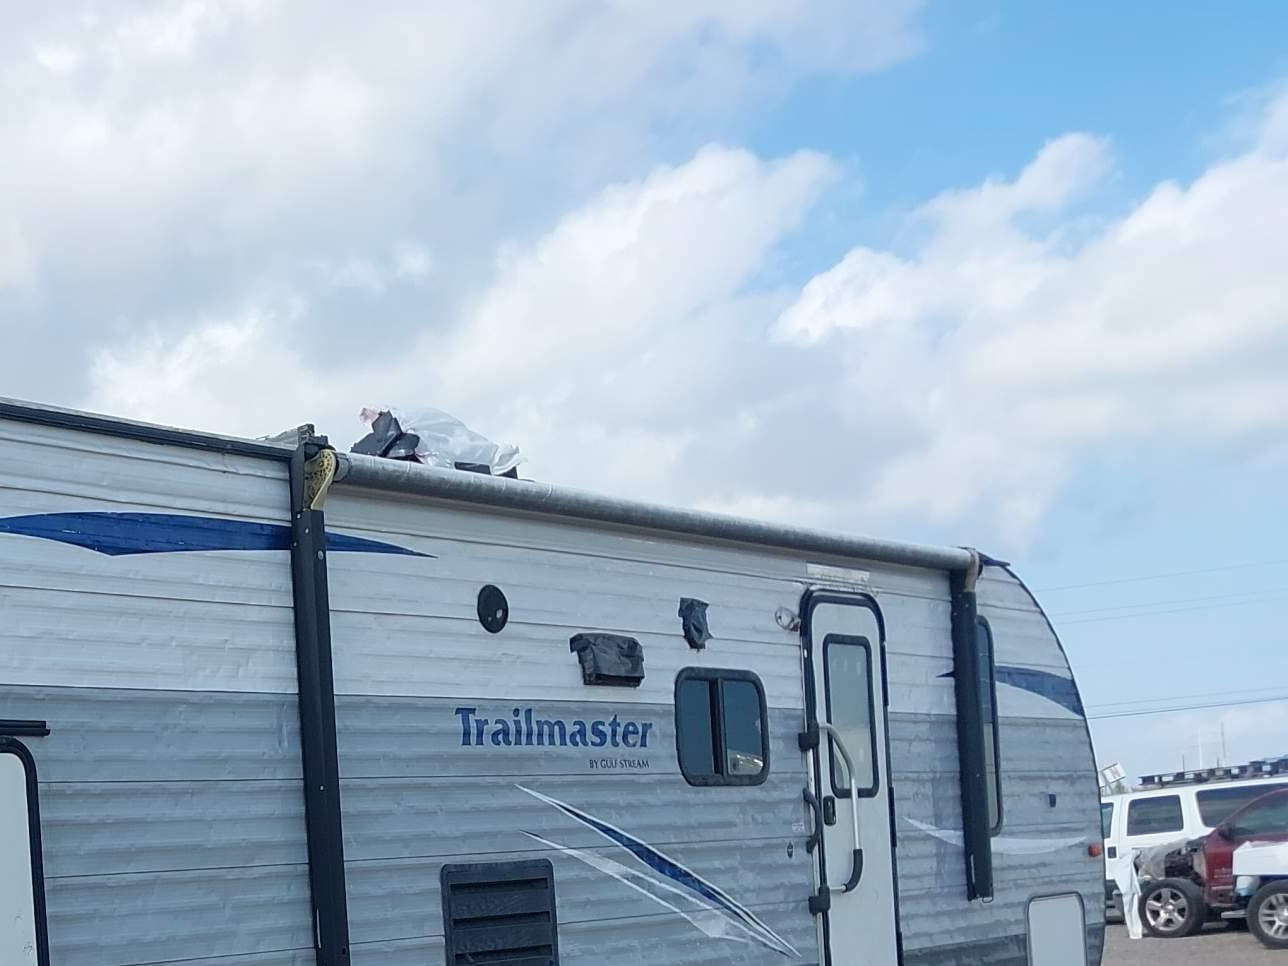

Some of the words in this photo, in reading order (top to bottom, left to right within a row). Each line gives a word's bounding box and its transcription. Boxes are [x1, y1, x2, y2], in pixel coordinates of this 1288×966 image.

[455, 707, 653, 748] Trailmaster
[589, 759, 598, 769] BY
[600, 759, 618, 769] GULF
[619, 759, 650, 769] STREAM
